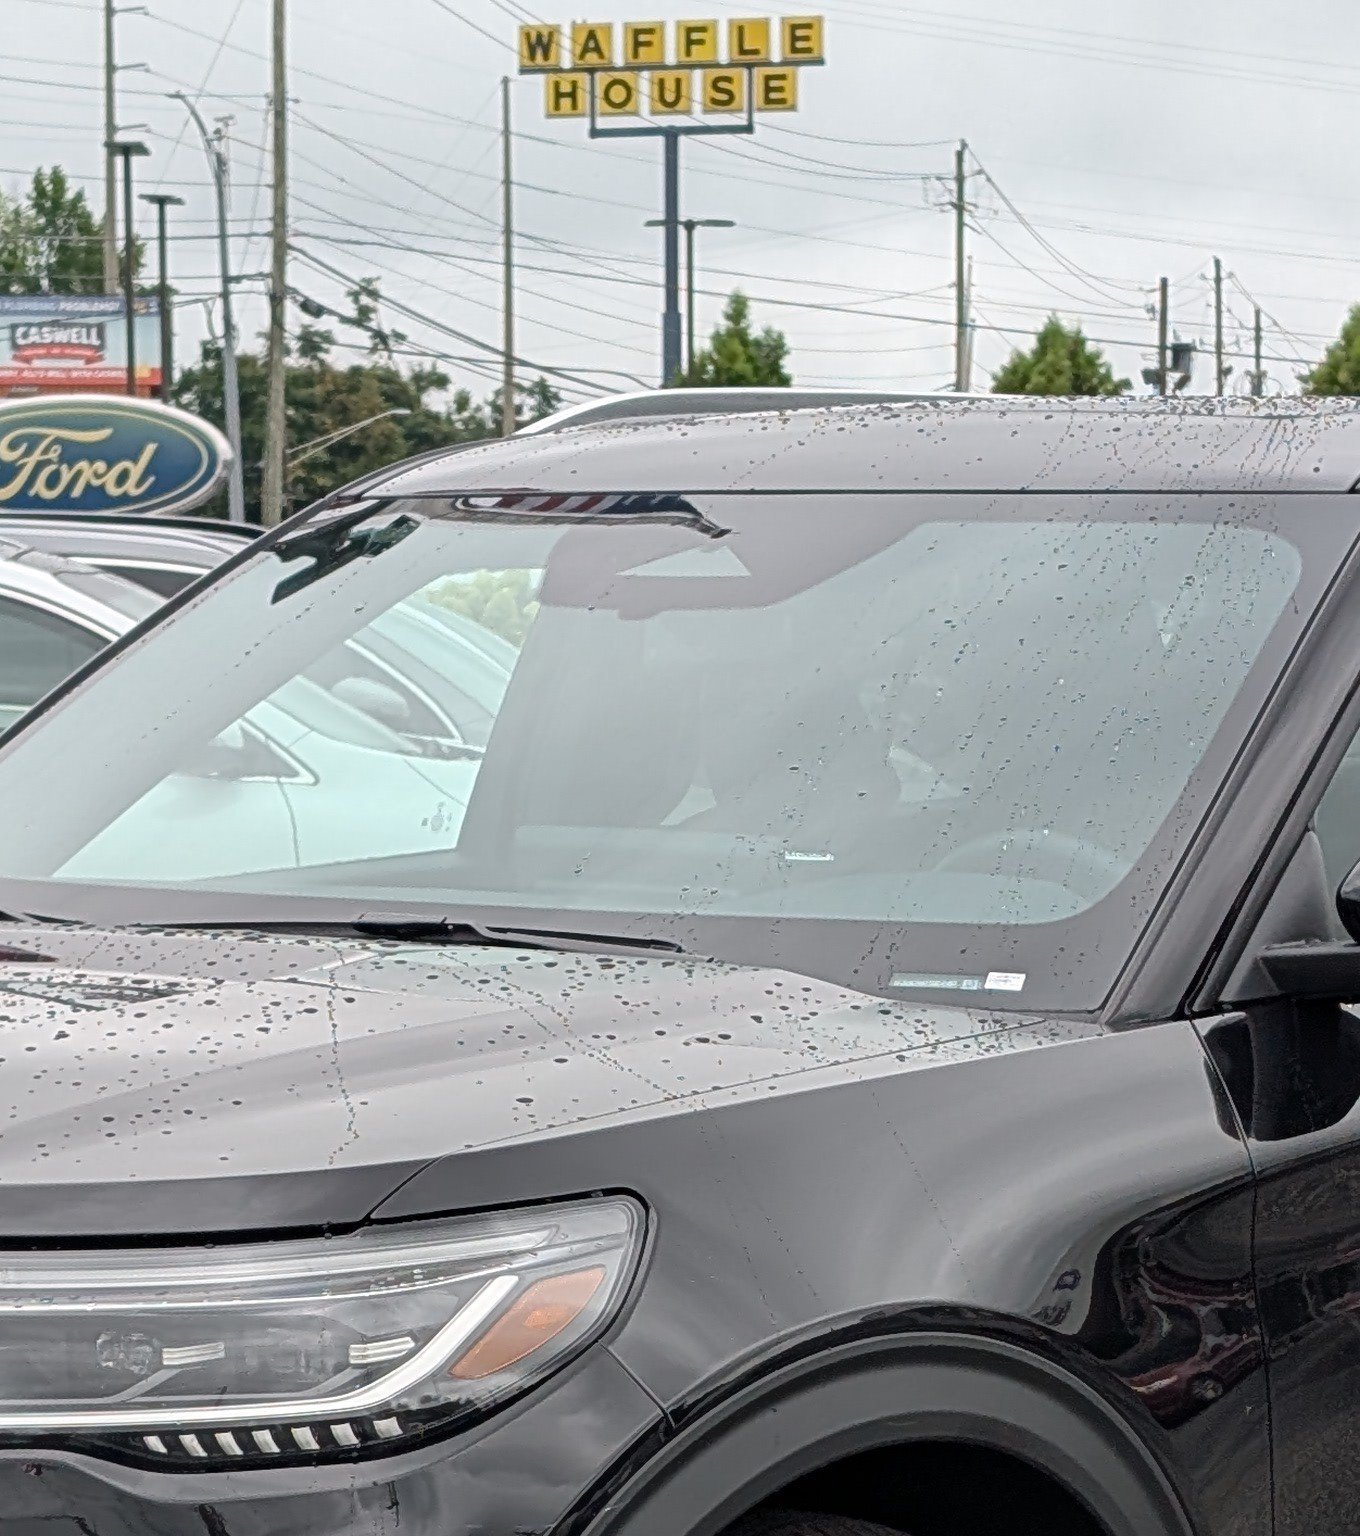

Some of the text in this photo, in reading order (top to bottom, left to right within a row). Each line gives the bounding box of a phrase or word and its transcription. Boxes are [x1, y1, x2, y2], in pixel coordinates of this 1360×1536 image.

[525, 22, 814, 62] WAFFLE
[553, 74, 788, 111] HOUSE
[15, 326, 101, 345] CASWELL
